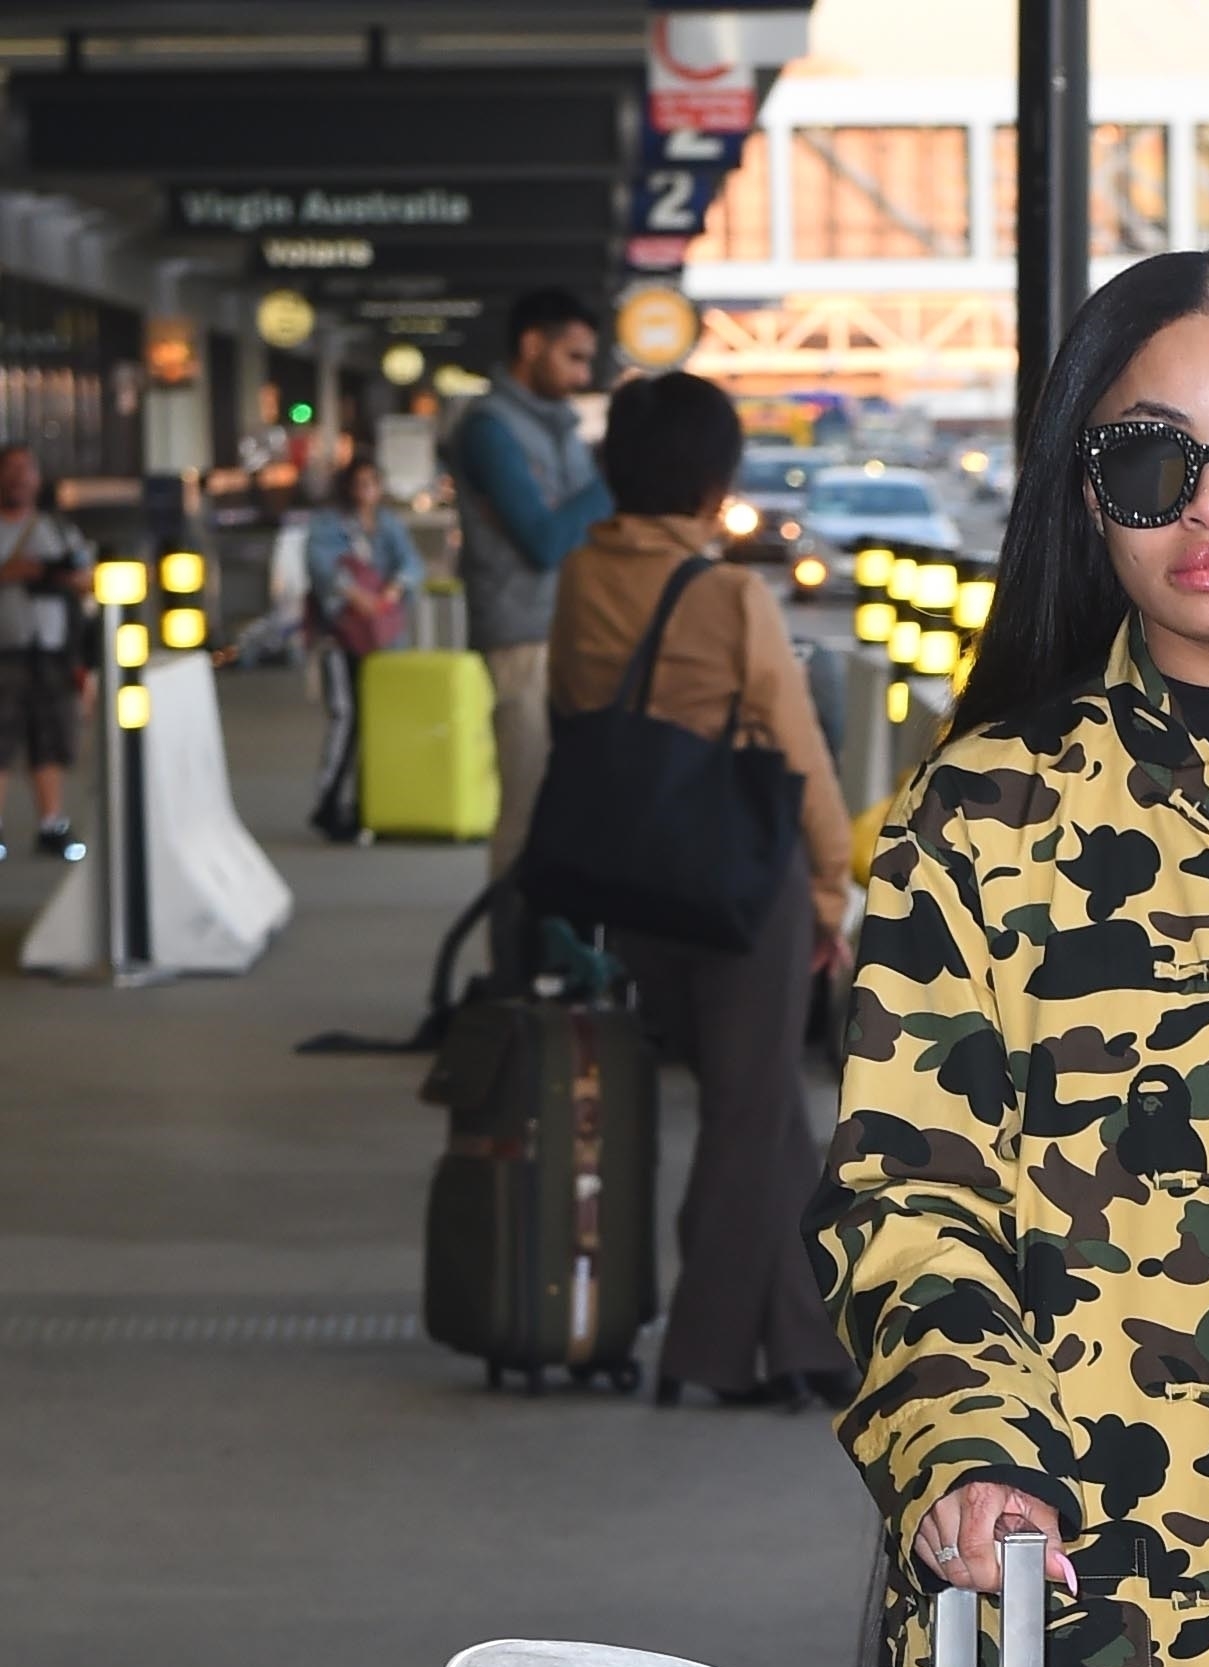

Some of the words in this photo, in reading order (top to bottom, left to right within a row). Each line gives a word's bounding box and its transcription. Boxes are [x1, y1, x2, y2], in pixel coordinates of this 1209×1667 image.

[183, 190, 293, 231] Virgin
[301, 188, 471, 225] Australia
[646, 170, 697, 229] 2
